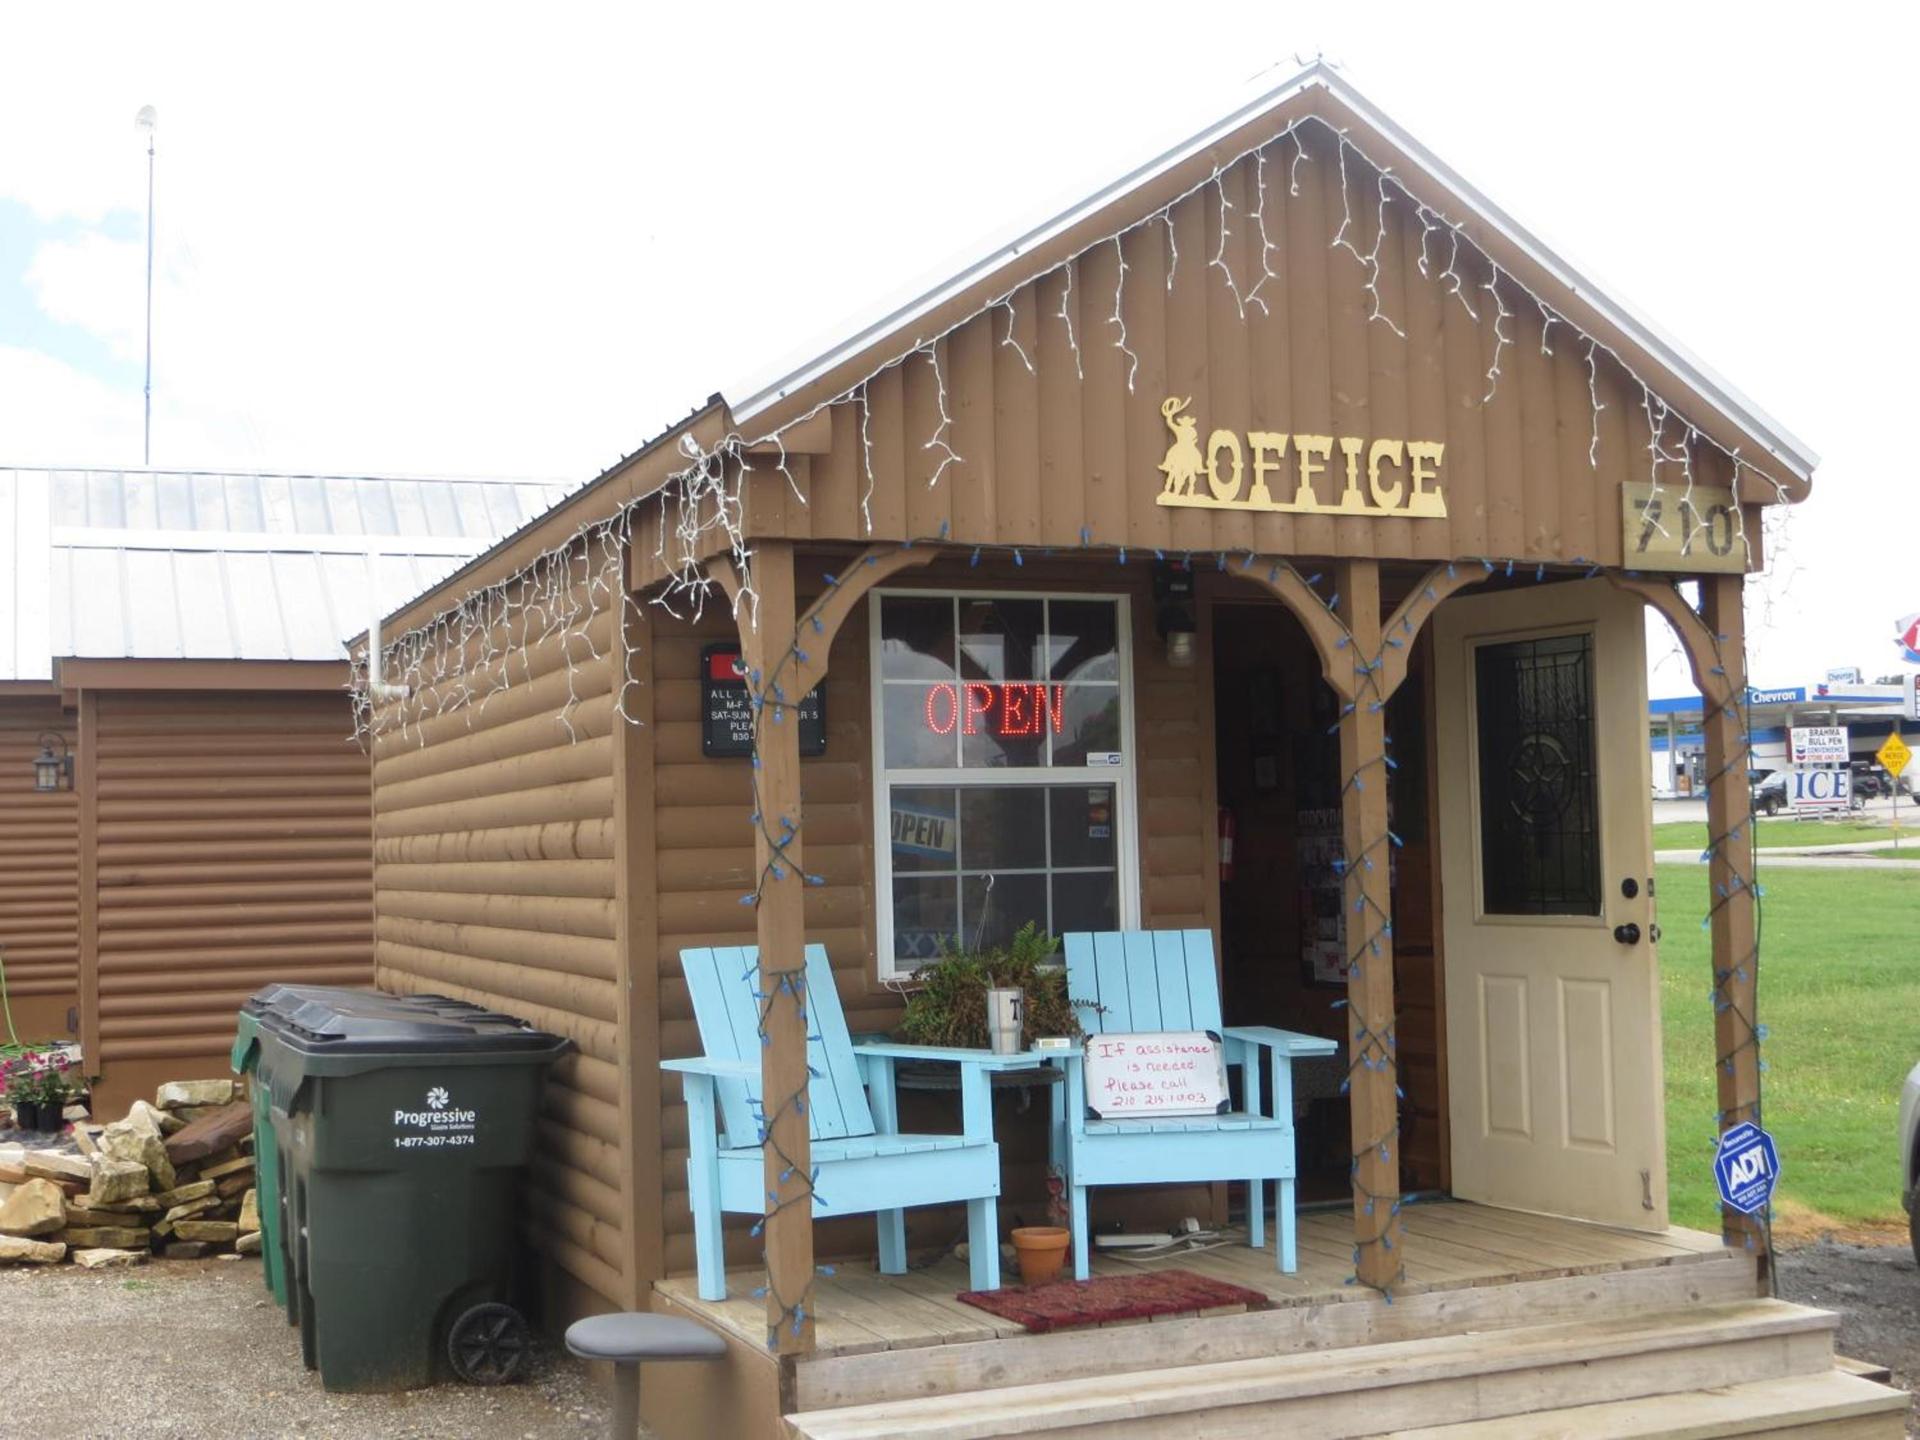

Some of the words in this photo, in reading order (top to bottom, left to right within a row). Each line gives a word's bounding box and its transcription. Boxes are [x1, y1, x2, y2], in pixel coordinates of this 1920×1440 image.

[1206, 429, 1447, 517] OFFICE
[1634, 499, 1733, 557] 710
[711, 690, 732, 699] ALL
[1751, 690, 1796, 704] Chevron
[711, 711, 750, 720] SAT-SUN
[925, 682, 1065, 736] OPEN
[730, 722, 755, 731] PLEA
[1808, 729, 1840, 737] BRAHMA
[1808, 737, 1827, 746] BULL
[1828, 737, 1843, 745] PEN
[1794, 772, 1847, 799] ICE
[891, 810, 945, 848] OPEN
[1098, 1042, 1126, 1058] If
[1127, 1061, 1141, 1072] is
[1104, 1077, 1154, 1092] Please
[1161, 1079, 1188, 1090] call
[395, 1108, 475, 1127] Progressive
[394, 1135, 474, 1147] 1-877-307-4374
[1731, 1145, 1765, 1191] ADT
